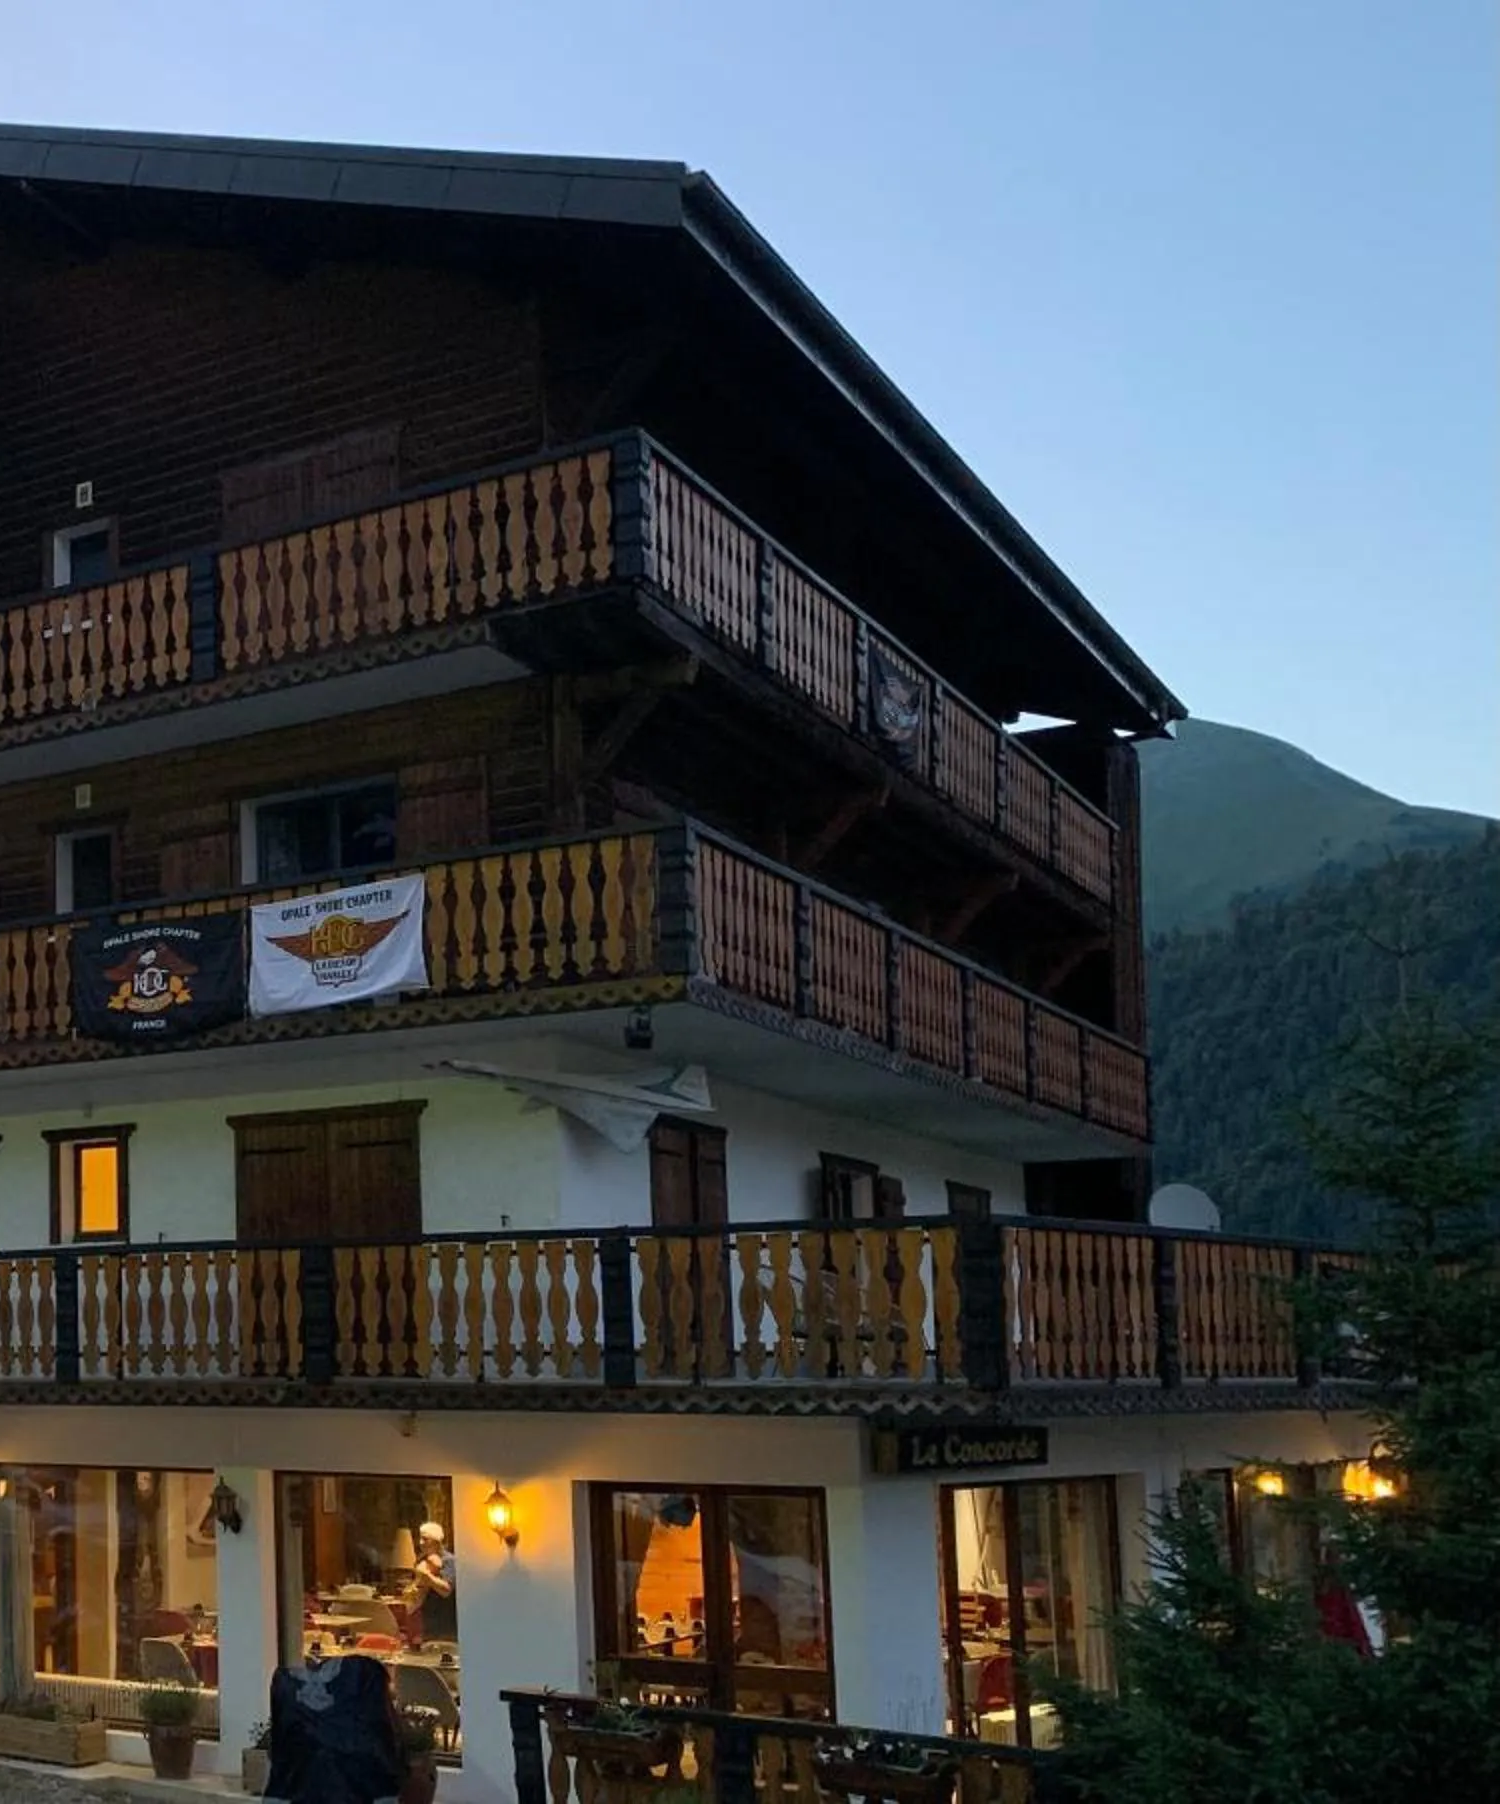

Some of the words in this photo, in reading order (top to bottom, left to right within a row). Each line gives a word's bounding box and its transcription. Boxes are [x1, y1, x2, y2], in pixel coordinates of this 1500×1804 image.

[281, 904, 311, 921] OPALE
[346, 888, 393, 908] CHAPTER
[103, 932, 131, 949] OPALE
[131, 927, 161, 941] SHORE
[162, 927, 201, 941] CHAPTER
[132, 1019, 167, 1030] FRANCE
[943, 1433, 1040, 1466] Concorde
